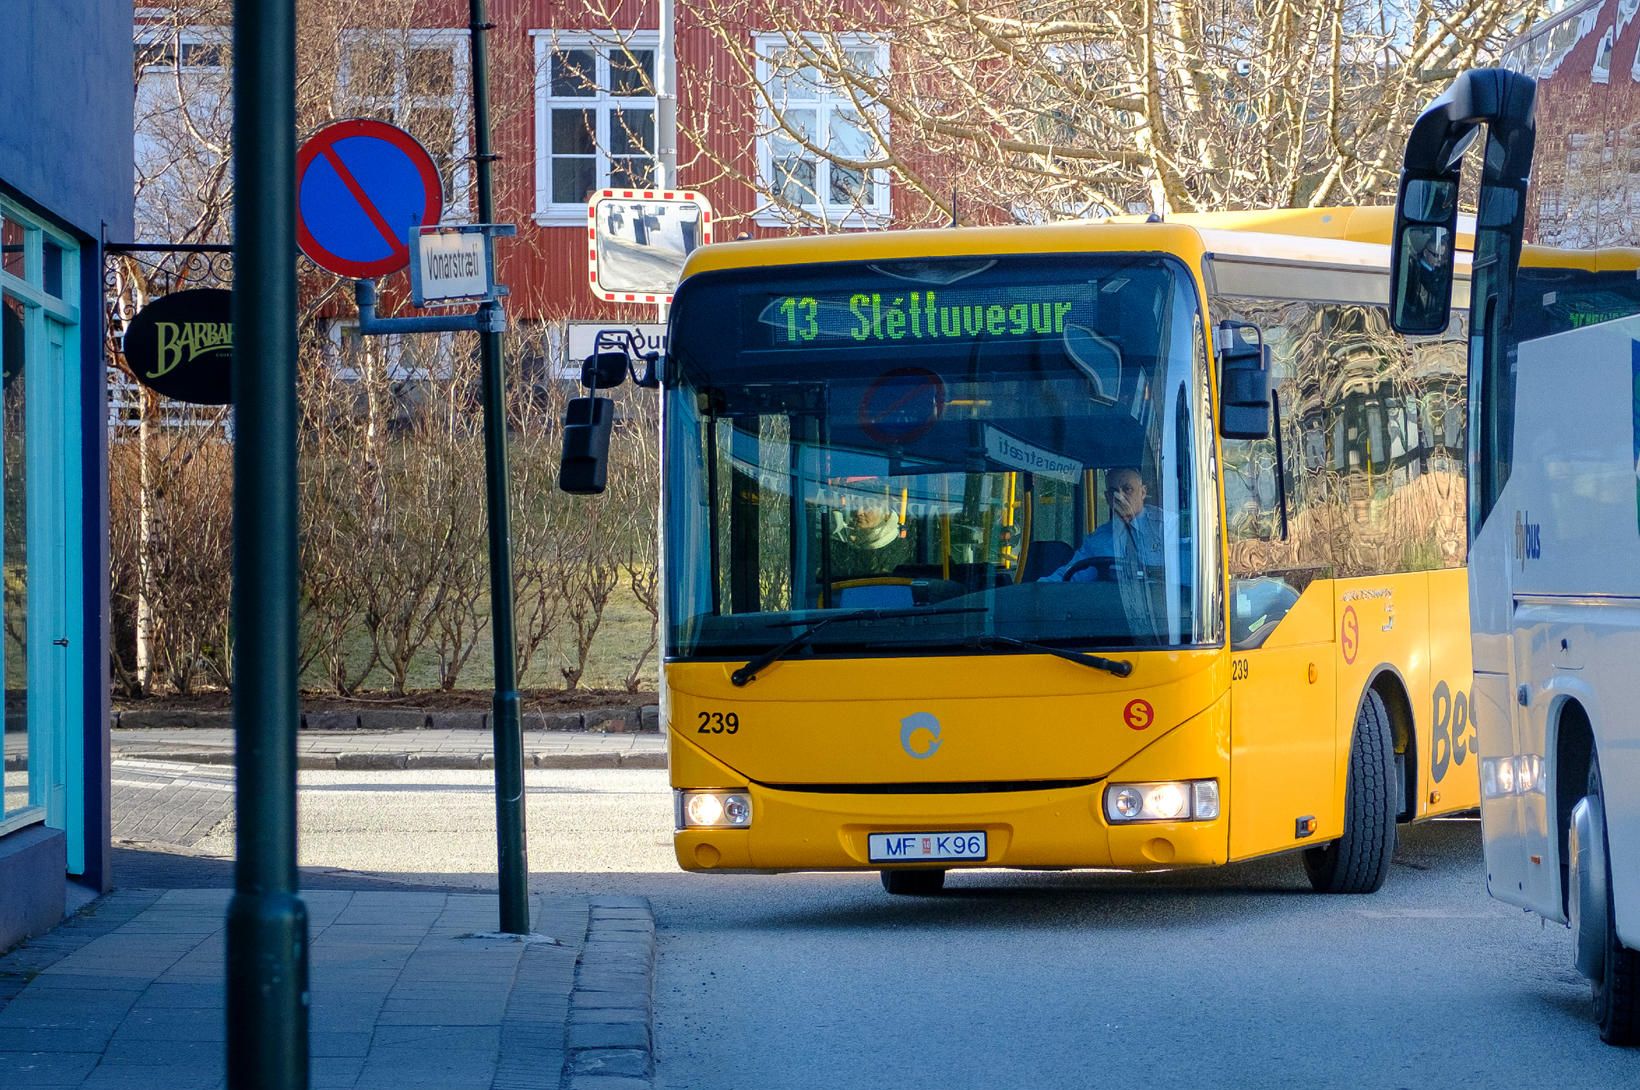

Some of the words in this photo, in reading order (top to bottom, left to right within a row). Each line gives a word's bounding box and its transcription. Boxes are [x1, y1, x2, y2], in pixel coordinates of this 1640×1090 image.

[426, 243, 479, 281] Vonarstræti
[780, 296, 818, 341] 13
[850, 290, 1072, 341] Sléttuvegur
[1232, 659, 1249, 681] 239
[697, 711, 739, 734] 239
[886, 838, 916, 855] MF
[937, 836, 981, 854] K96
